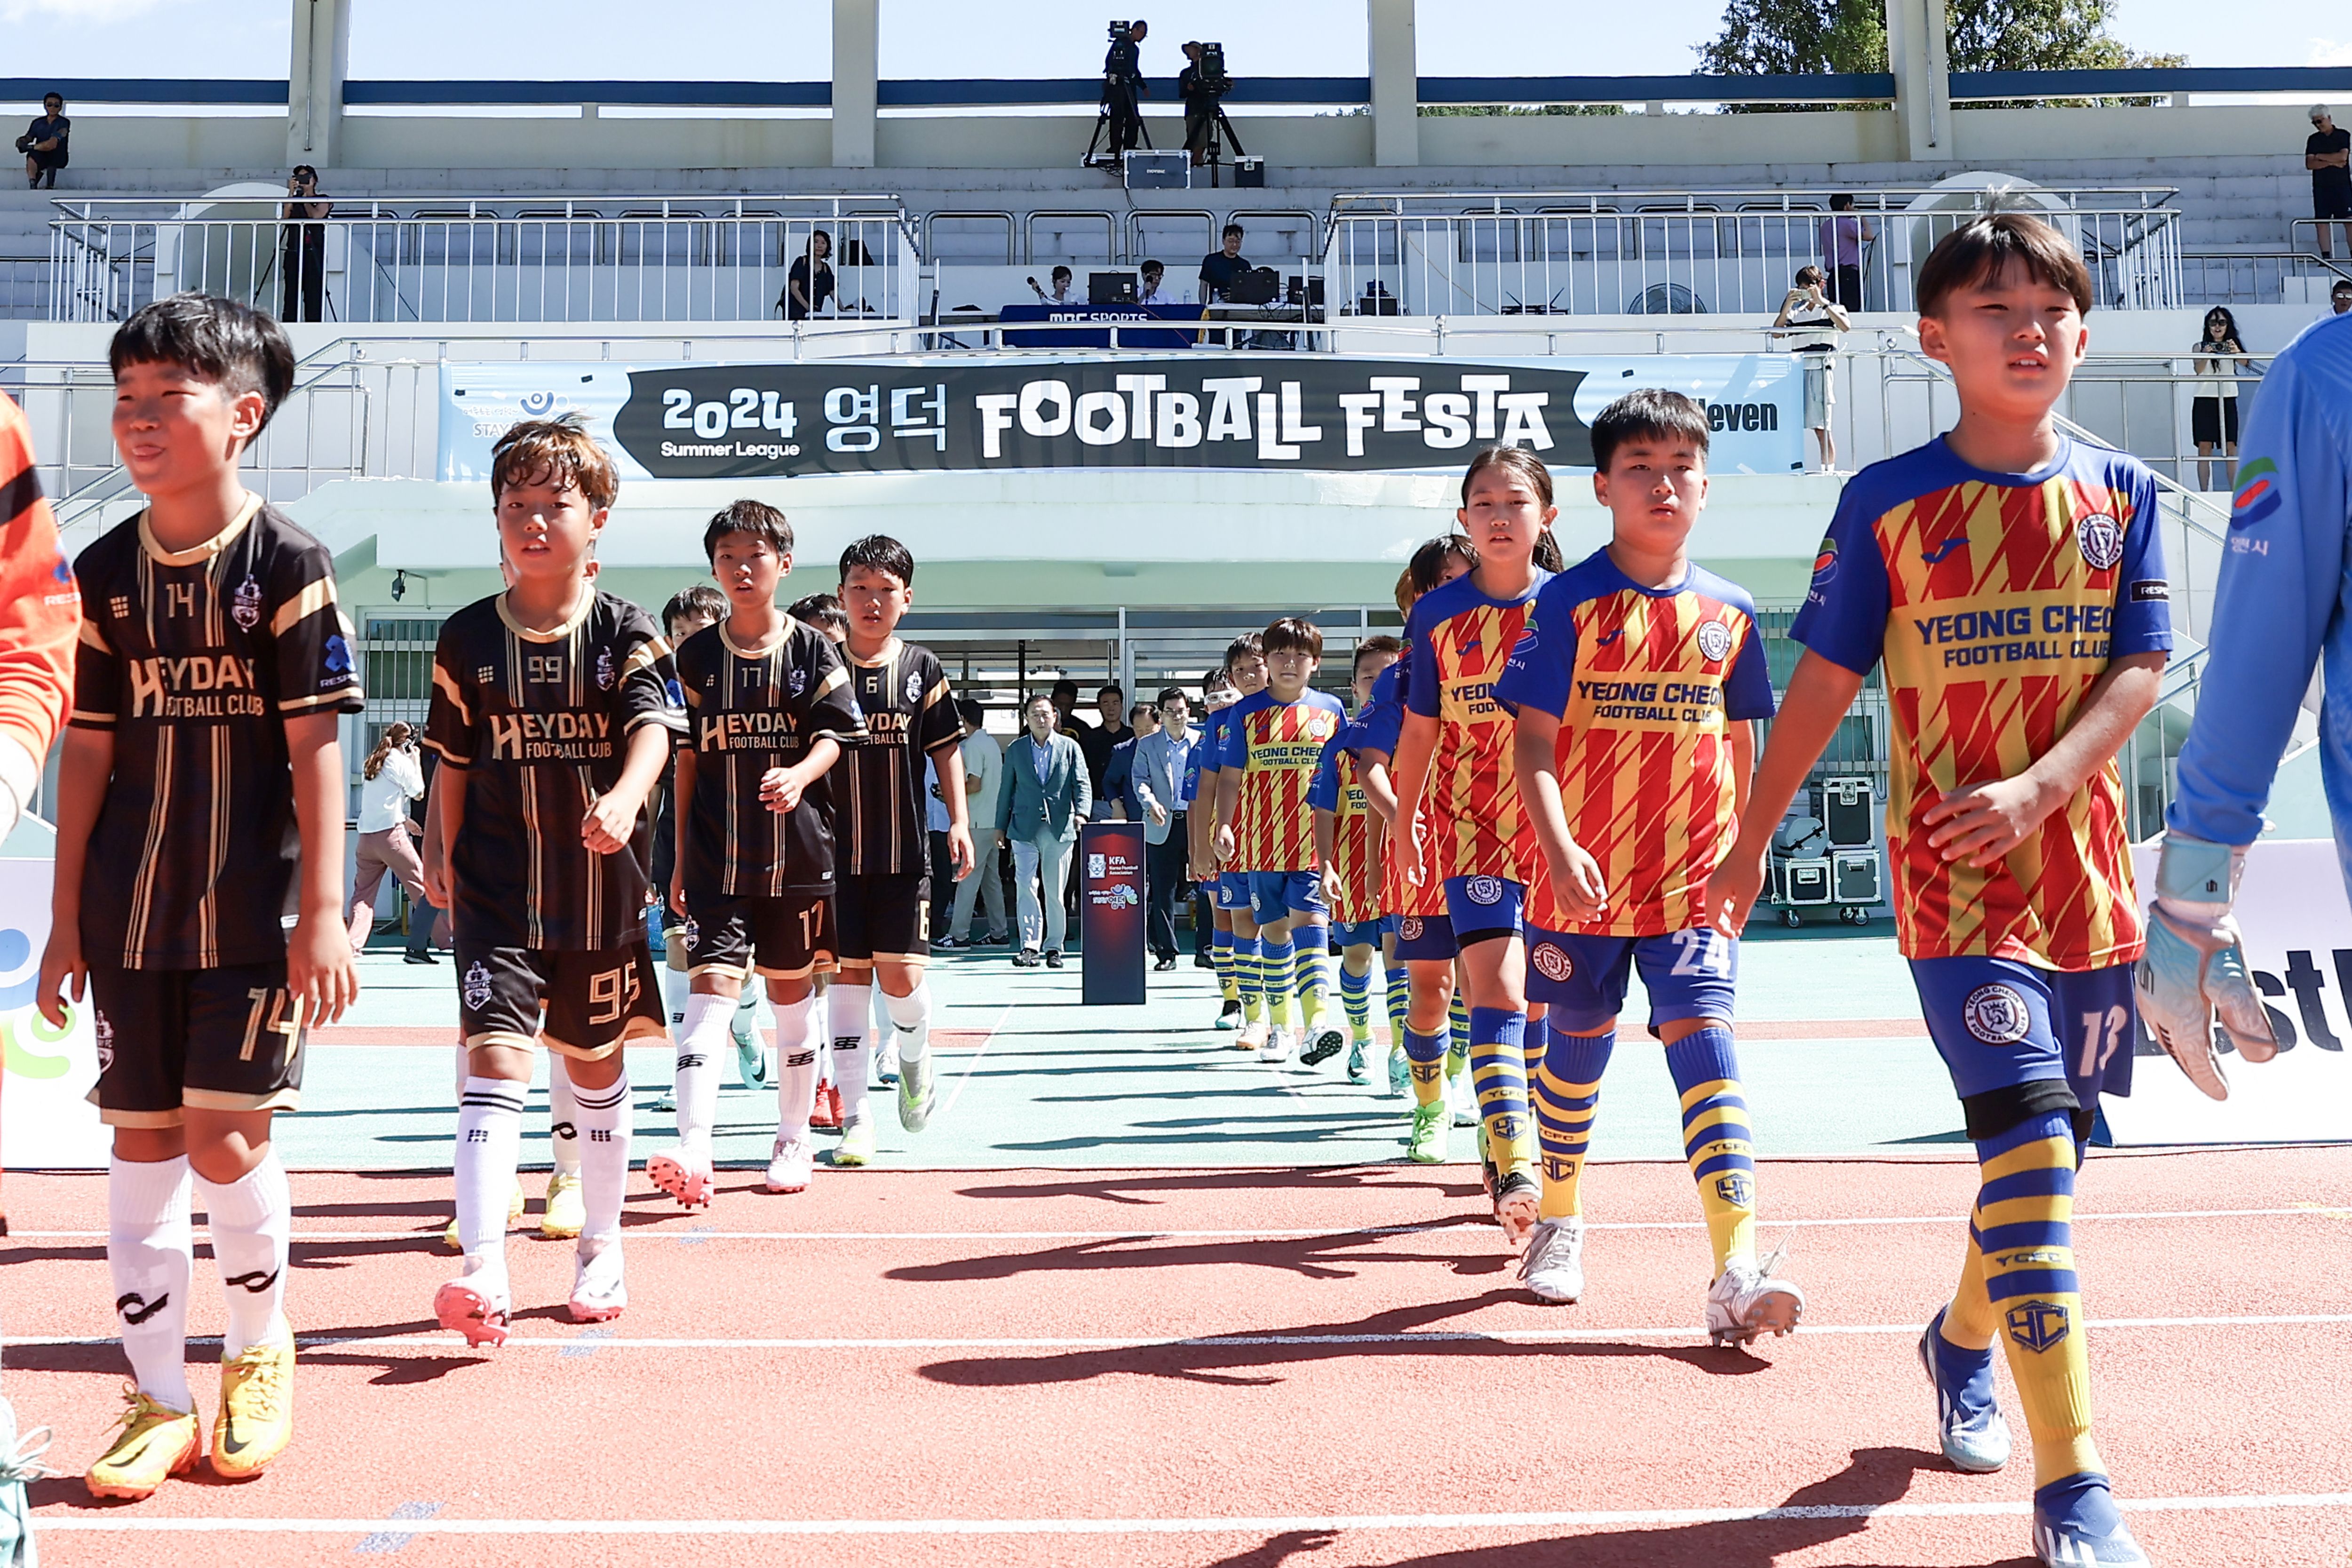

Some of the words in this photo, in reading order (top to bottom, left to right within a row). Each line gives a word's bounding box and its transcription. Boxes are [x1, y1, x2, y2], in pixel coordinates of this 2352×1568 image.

[1090, 313, 1147, 322] SPORTS
[662, 387, 798, 439] 2024
[824, 384, 946, 452] 영덕
[975, 374, 1322, 460] FOOTBALL
[1338, 374, 1555, 456] FESTA
[474, 423, 509, 436] STAY
[660, 441, 733, 457] Summer
[735, 441, 800, 459] League
[2082, 546, 2106, 566] FOOTBA
[165, 583, 195, 618] 14
[1914, 607, 2031, 645] YEONG
[2042, 605, 2114, 633] CHEO
[1507, 658, 1526, 670] 천시
[1944, 640, 2064, 668] FOOTBALL
[2070, 639, 2108, 659] CLUB
[528, 656, 563, 683] 99
[741, 667, 762, 687] 17
[866, 676, 878, 694] 6
[1451, 682, 1498, 702] YEO
[1577, 680, 1658, 702] YEONG
[227, 693, 264, 716] CLUB
[1593, 705, 1677, 721] FOOTBALL
[700, 712, 797, 752] HEYDAY
[864, 712, 913, 731] YDAY
[489, 712, 610, 760] HEYDAY
[730, 736, 778, 749] FOOTBALL
[780, 735, 799, 749] CLUB
[588, 741, 612, 758] CUB
[1251, 747, 1288, 759] YEONG
[1292, 746, 1323, 759] CHEO
[1261, 757, 1299, 766] OOTBALL
[1109, 856, 1126, 865] KFA
[799, 900, 824, 950] 17
[919, 899, 930, 941] 6
[1670, 928, 1731, 980] 24
[1967, 987, 1990, 1010] YEONG
[1993, 986, 2020, 1003] CHEON
[239, 987, 305, 1067] 14
[2079, 1004, 2127, 1076] 13
